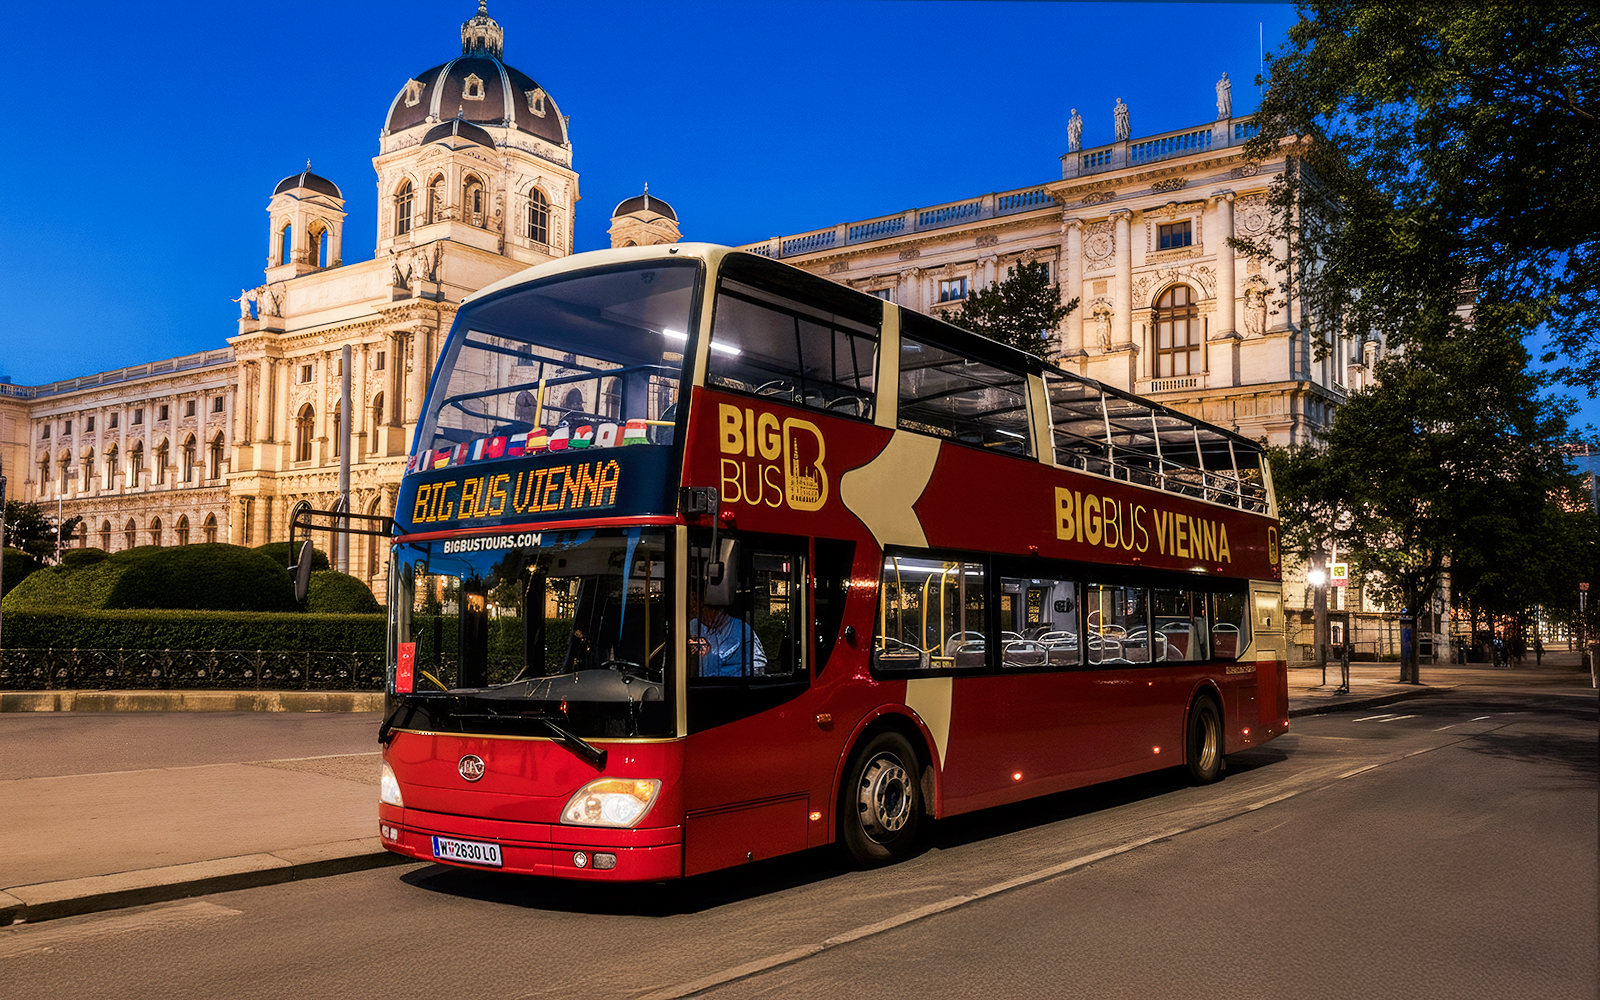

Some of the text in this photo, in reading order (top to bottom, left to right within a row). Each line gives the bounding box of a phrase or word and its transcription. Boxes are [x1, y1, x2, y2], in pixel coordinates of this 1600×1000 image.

[719, 403, 781, 460] BIG
[412, 459, 620, 523] BIG BUS VIENNA
[720, 458, 783, 508] BUS
[443, 533, 542, 554] BIGBUSTOURS.COM
[1153, 508, 1231, 563] VIENNA
